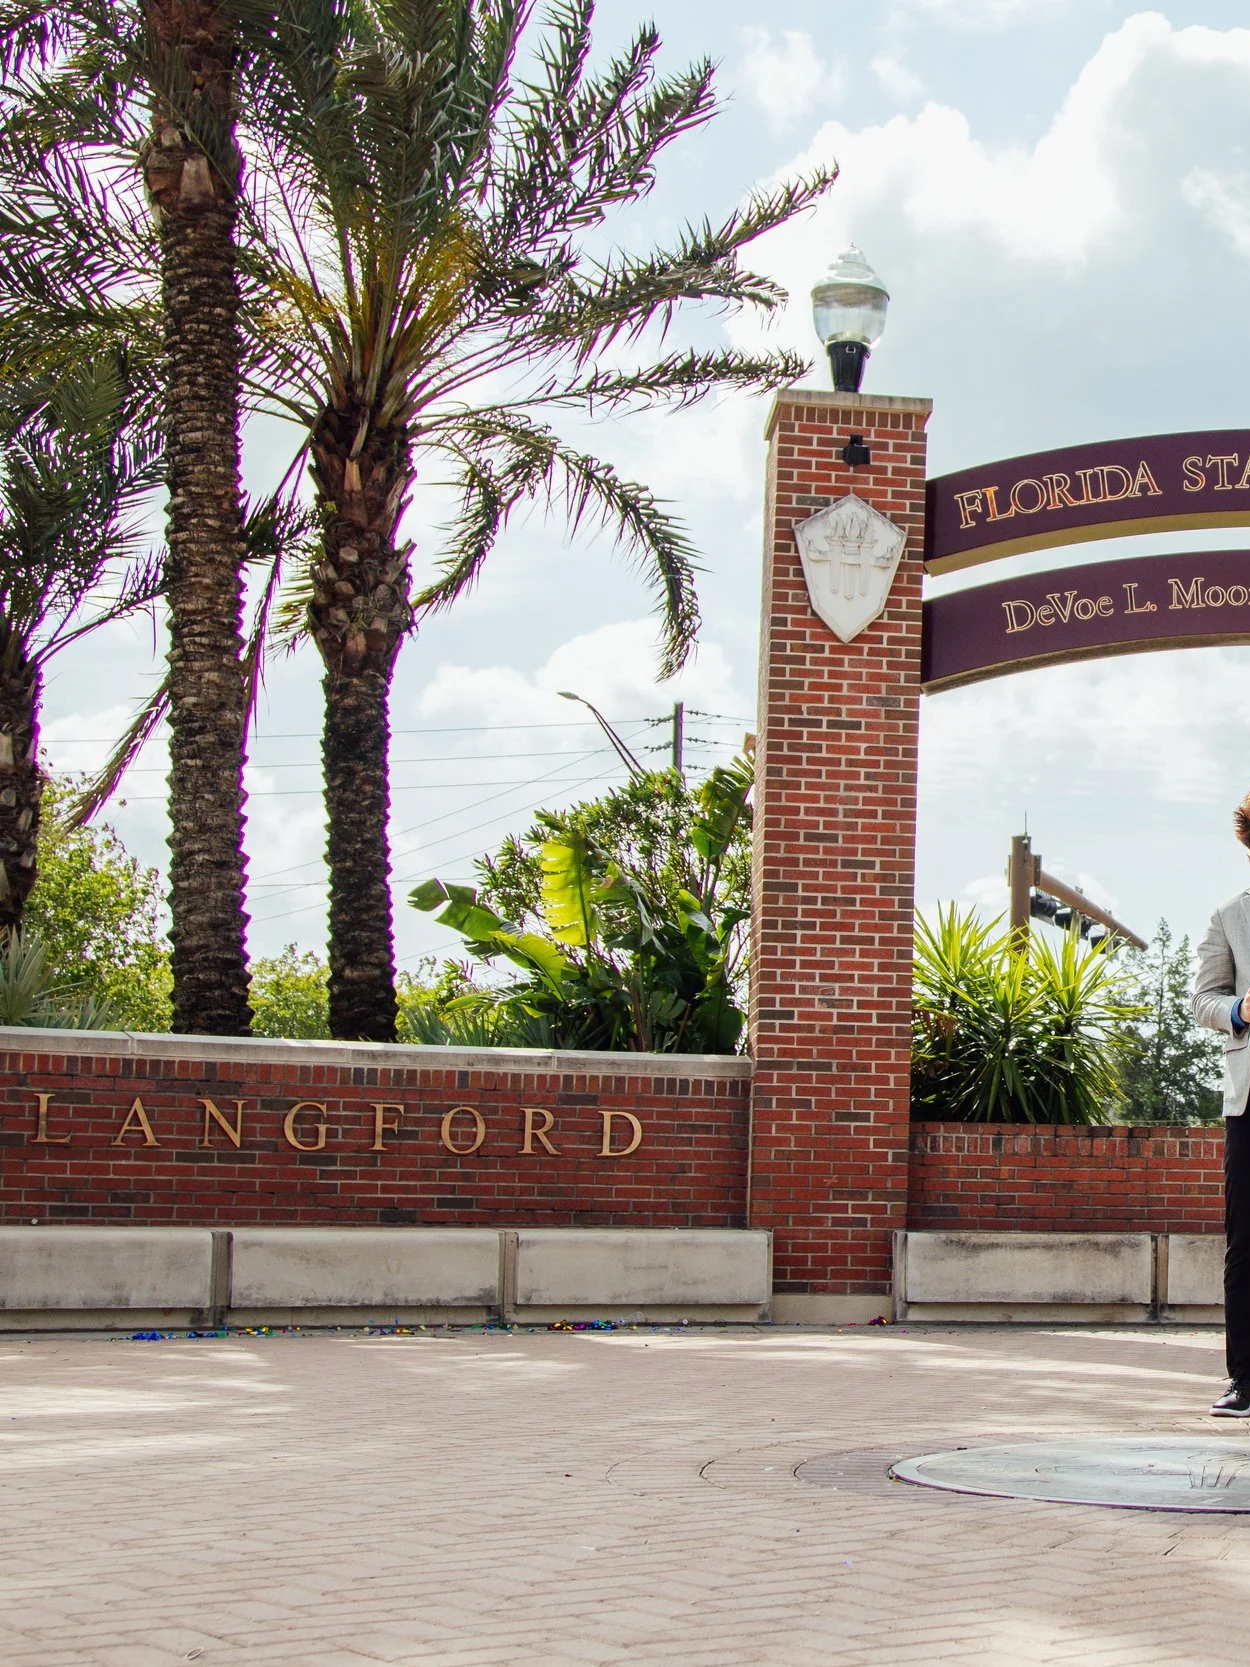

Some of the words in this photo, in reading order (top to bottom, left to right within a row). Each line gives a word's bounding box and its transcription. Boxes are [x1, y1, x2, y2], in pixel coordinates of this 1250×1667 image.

[954, 461, 1162, 529] FLORIDA
[1002, 591, 1114, 634] DeVoe
[1123, 583, 1157, 614] L.
[30, 1092, 644, 1157] LANGFORD
